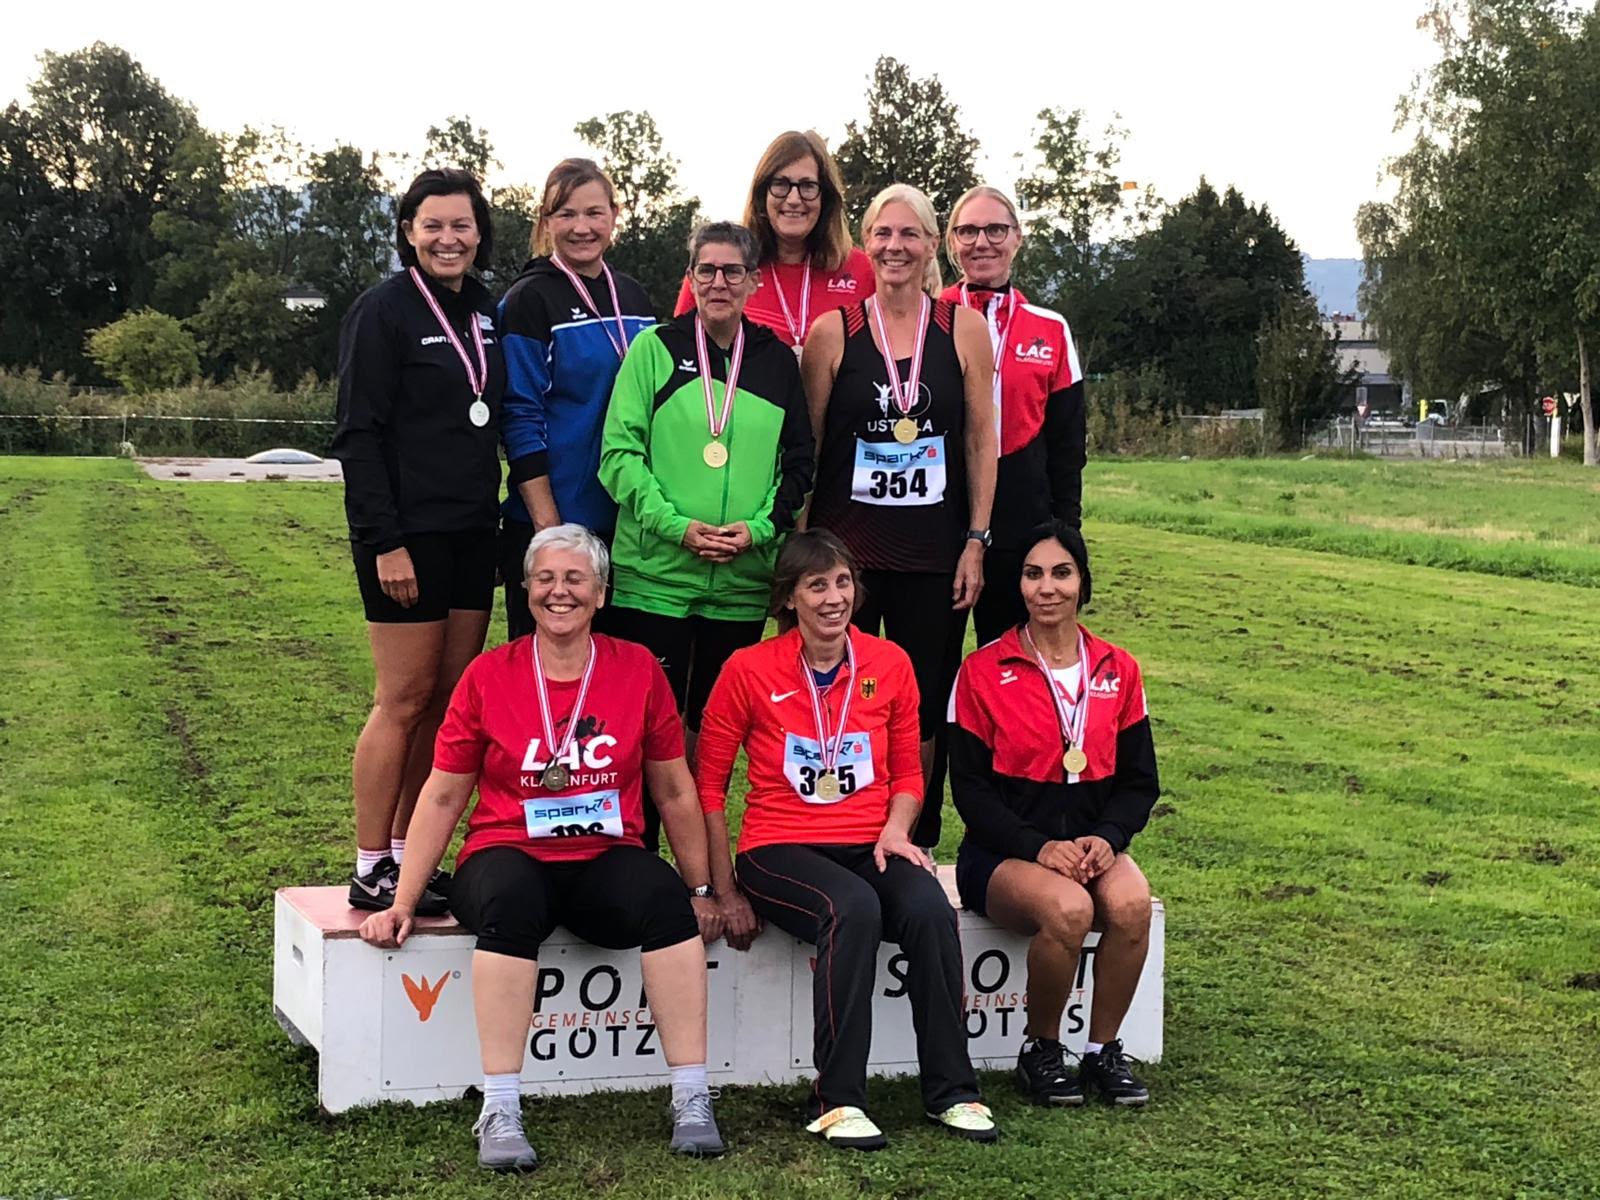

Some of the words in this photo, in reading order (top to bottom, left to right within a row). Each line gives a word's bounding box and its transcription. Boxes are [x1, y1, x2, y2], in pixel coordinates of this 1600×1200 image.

[827, 278, 857, 290] LAC
[1015, 343, 1053, 359] LAC
[867, 419, 933, 432] USTLA
[869, 468, 928, 499] 354
[1089, 676, 1121, 692] LAC
[520, 734, 618, 771] LAC
[520, 772, 618, 788] KLNFURT
[883, 946, 1098, 998] SOT
[531, 1010, 656, 1028] GEMEINSC
[530, 1024, 656, 1061] GÖTZ
